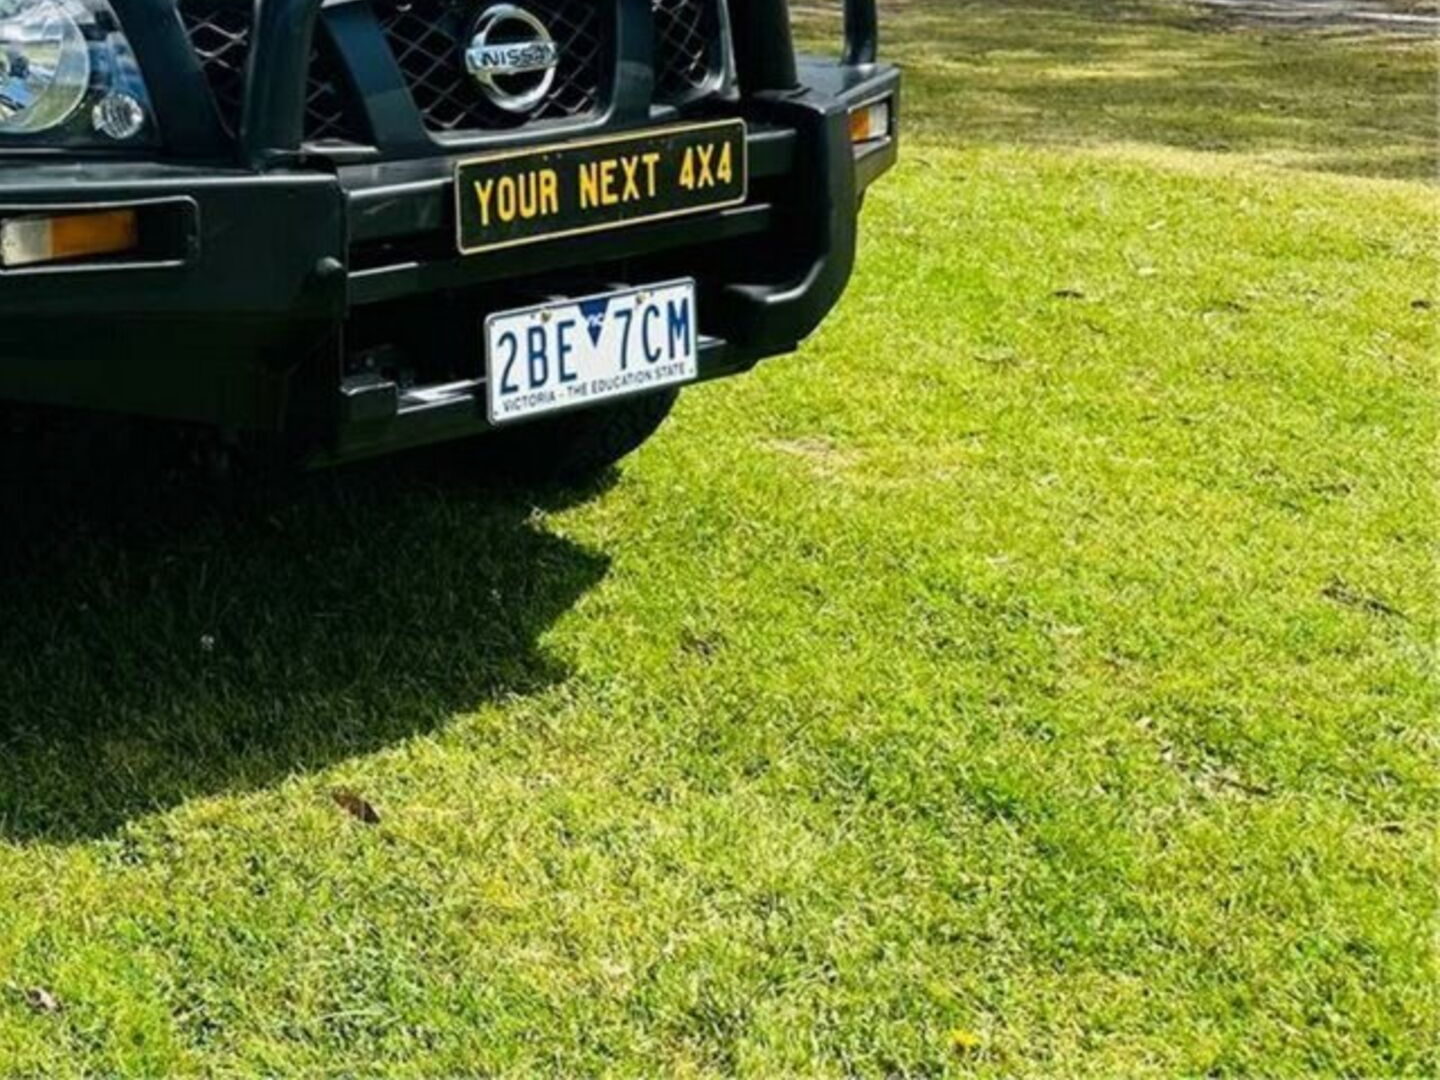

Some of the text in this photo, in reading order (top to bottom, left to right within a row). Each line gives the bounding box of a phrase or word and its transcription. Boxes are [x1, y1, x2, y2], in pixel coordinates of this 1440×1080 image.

[474, 141, 732, 226] YOUR NEXT 4X4
[614, 298, 690, 370] 7CM
[502, 391, 556, 413] VICTORIA
[567, 381, 588, 397] THE
[591, 369, 653, 394] EDUCATION
[656, 361, 686, 378] STATE
